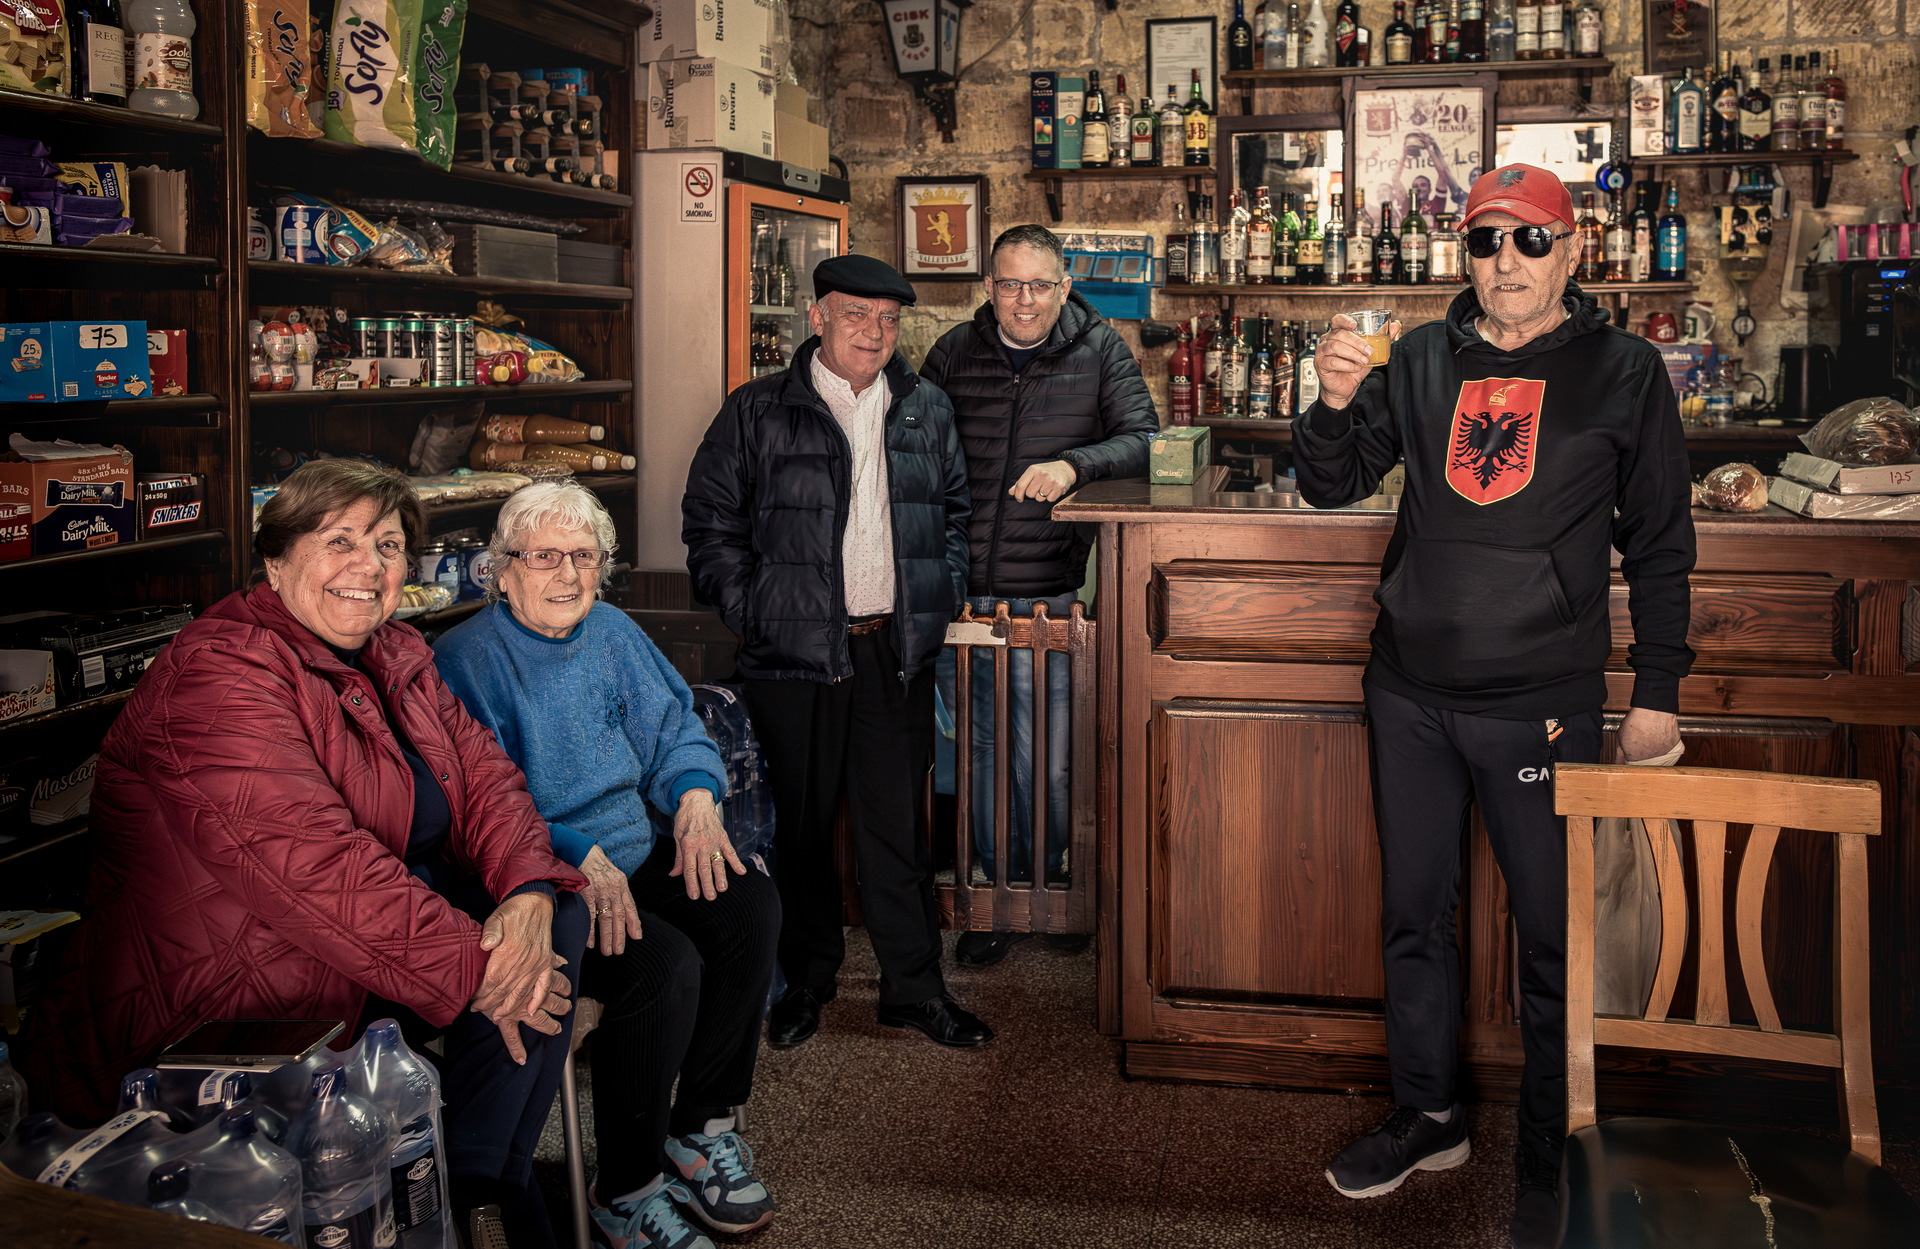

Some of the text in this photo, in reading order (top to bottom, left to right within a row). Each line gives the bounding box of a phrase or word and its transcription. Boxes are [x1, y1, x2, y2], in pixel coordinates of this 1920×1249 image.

[439, 7, 454, 27] 150
[893, 9, 929, 22] CISK
[334, 38, 344, 80] TOVAGLIOLI
[688, 65, 694, 75] 6
[328, 91, 340, 110] 150
[665, 79, 674, 128] Bavaria
[1438, 104, 1468, 124] 20
[105, 172, 115, 196] GUSTO
[91, 327, 117, 350] 75
[72, 470, 109, 482] STANDARD
[2, 485, 29, 496] BARS
[60, 491, 81, 501] Dairy
[152, 503, 199, 524] SNICKERS
[62, 527, 90, 541] Dairy
[409, 1159, 433, 1178] FONTANA
[315, 1229, 347, 1243] FONTANA
